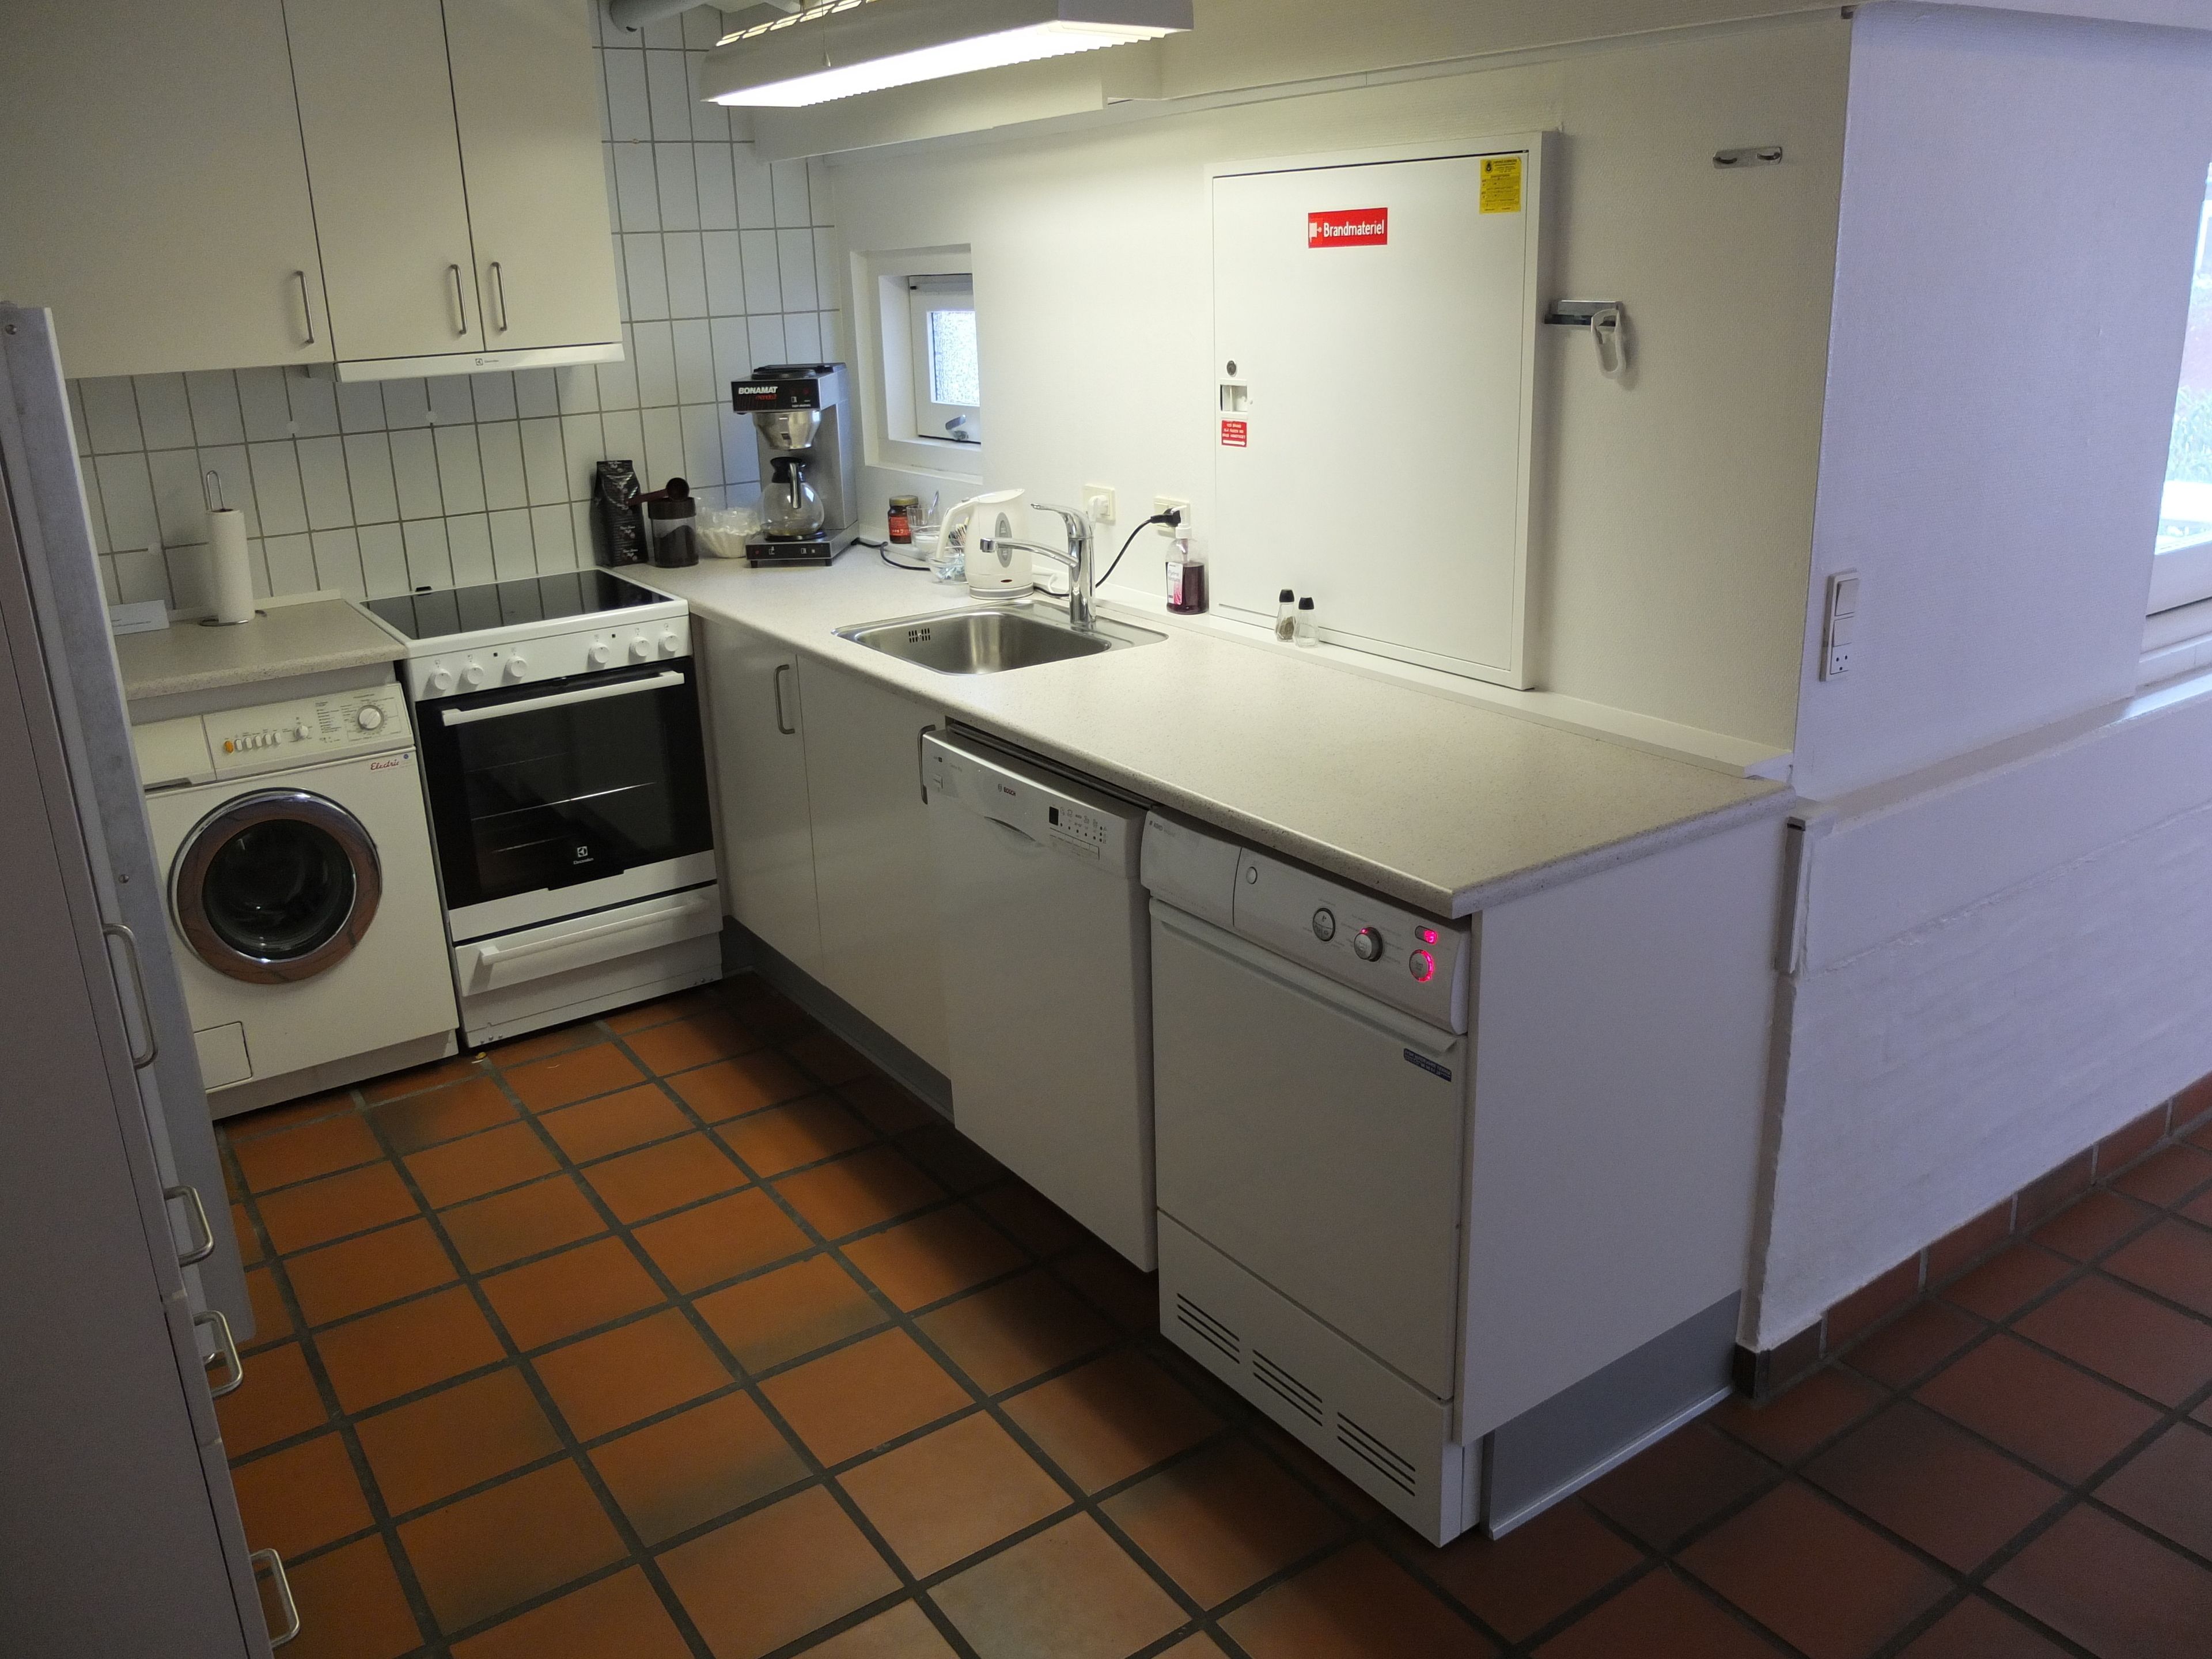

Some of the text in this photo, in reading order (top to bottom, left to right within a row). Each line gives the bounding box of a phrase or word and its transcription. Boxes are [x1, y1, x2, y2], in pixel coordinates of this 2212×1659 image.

[1323, 219, 1385, 237] Brandmateriel
[738, 386, 778, 395] BONAMAT
[370, 759, 400, 770] Electric
